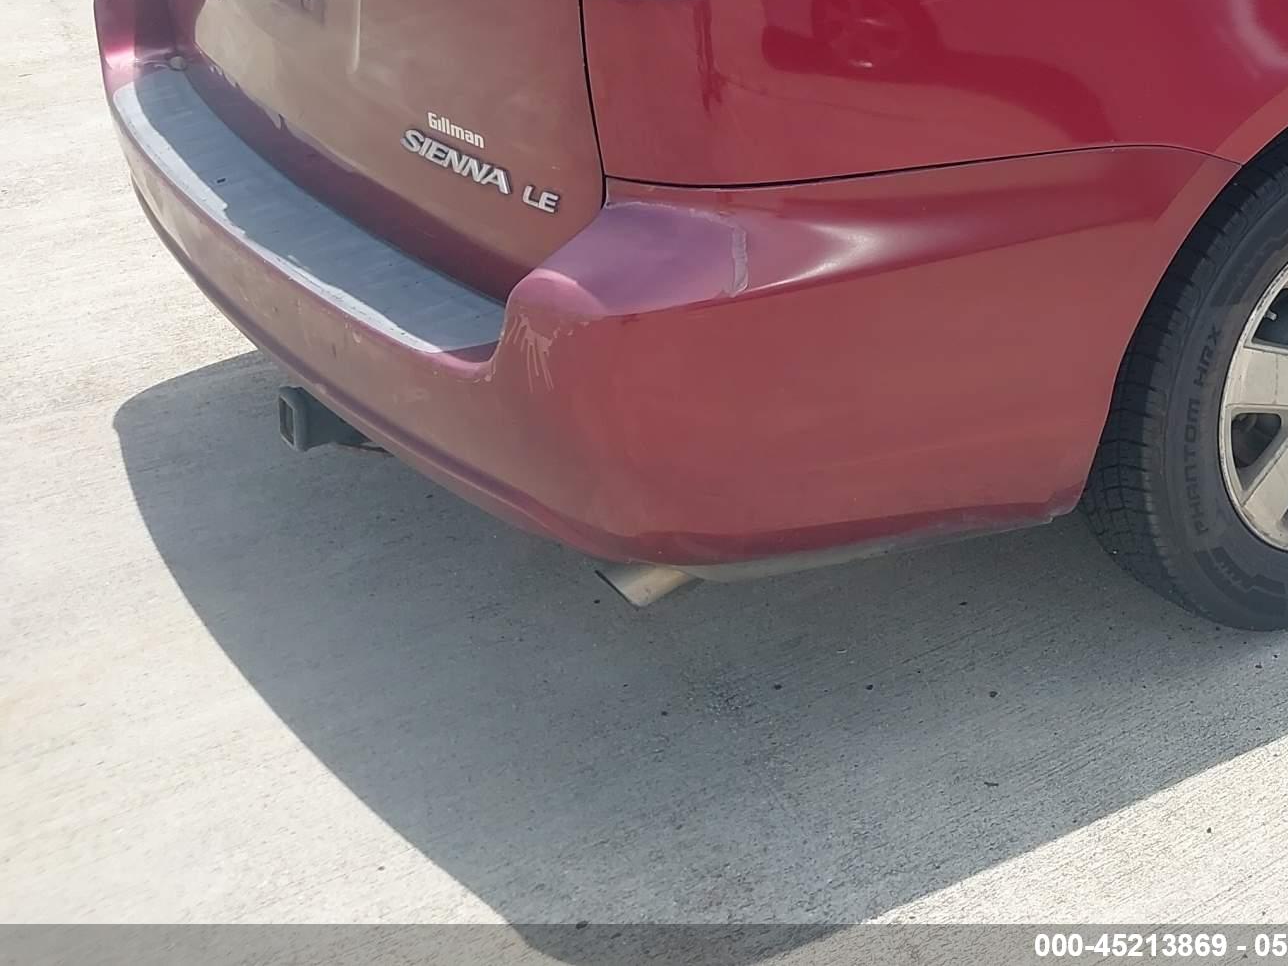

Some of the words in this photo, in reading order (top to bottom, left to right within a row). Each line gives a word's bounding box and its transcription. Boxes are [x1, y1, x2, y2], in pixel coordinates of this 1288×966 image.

[427, 111, 485, 149] Gillman
[402, 129, 511, 194] SIENNA
[523, 185, 560, 213] LE
[1193, 322, 1221, 387] HRX
